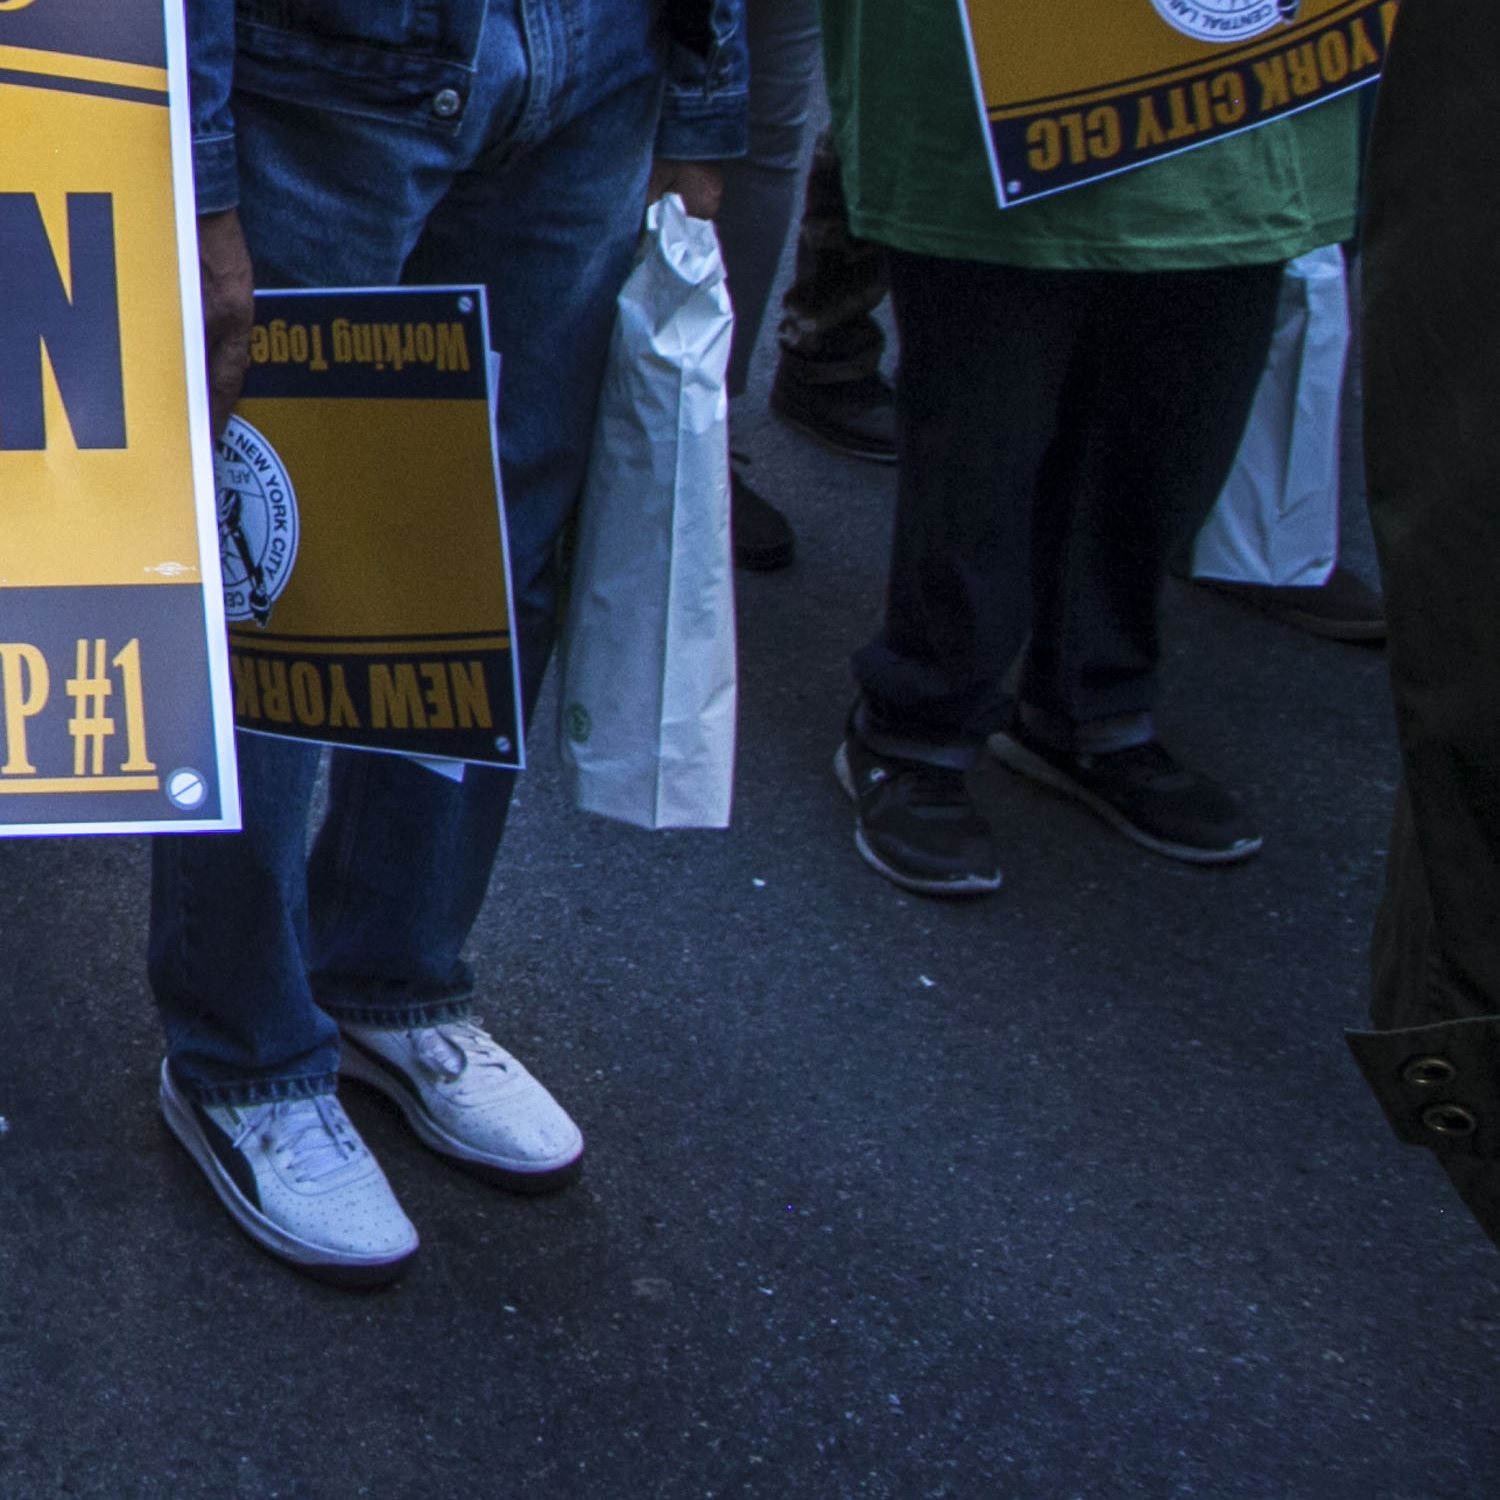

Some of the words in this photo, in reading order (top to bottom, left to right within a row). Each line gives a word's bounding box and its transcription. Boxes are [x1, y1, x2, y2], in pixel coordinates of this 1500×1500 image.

[1201, 2, 1273, 31] CENTRAL
[1252, 18, 1379, 113] YORK
[1024, 104, 1124, 172] CLC
[1134, 71, 1247, 150] CITY
[332, 318, 470, 371] Working
[235, 433, 272, 472] NEW
[264, 474, 288, 533] YORK
[263, 537, 287, 581] CITY
[65, 637, 158, 777] #1
[231, 655, 361, 728] YORK
[368, 661, 493, 729] NEW
